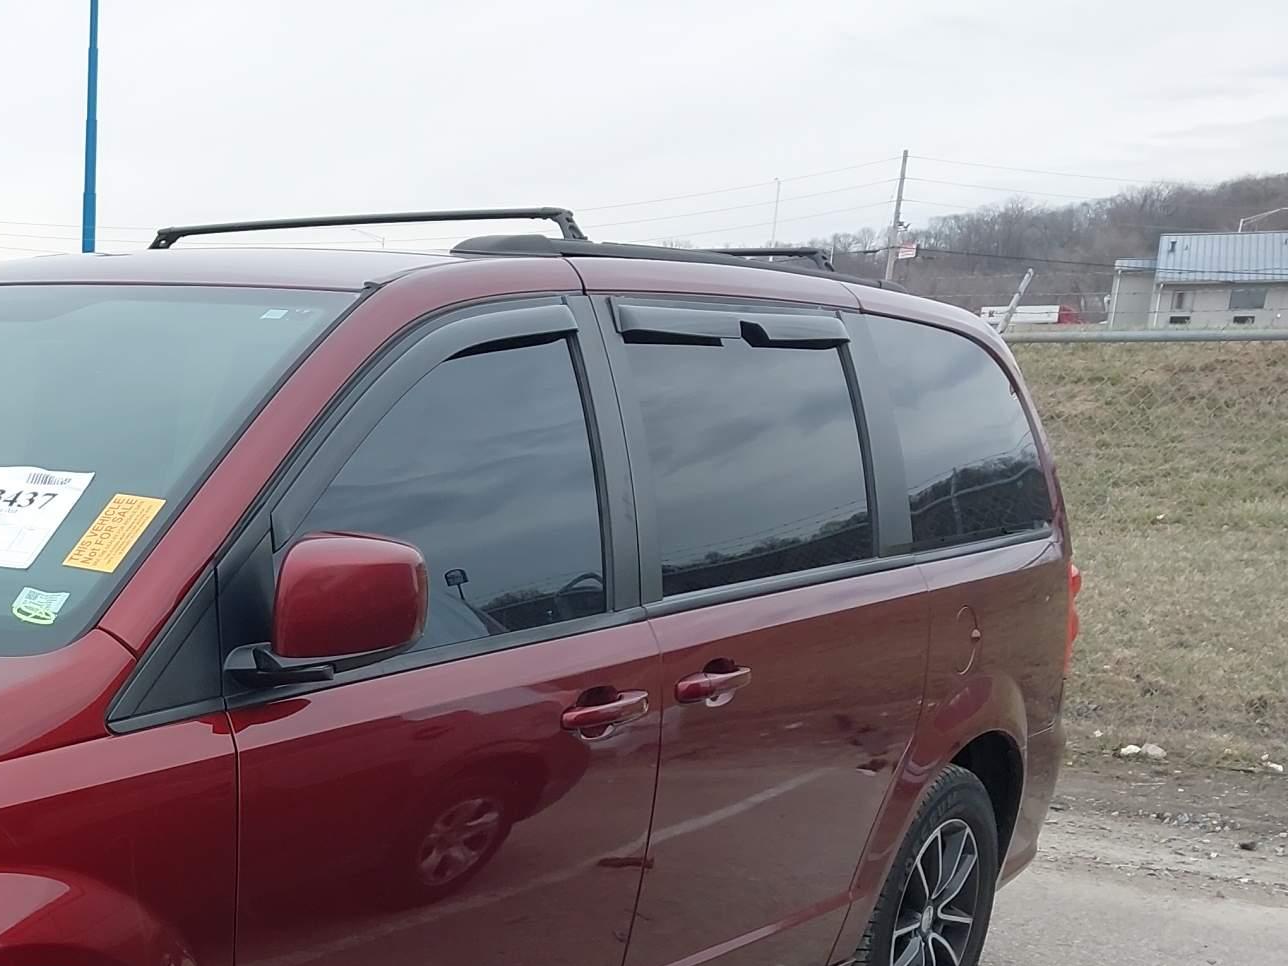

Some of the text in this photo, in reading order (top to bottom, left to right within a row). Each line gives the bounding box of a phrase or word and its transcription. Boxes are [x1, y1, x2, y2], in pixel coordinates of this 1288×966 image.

[69, 541, 92, 562] THIS
[88, 497, 126, 539] VEHICLE
[80, 548, 100, 565] Not
[95, 525, 117, 546] FOR
[112, 498, 138, 524] SALE
